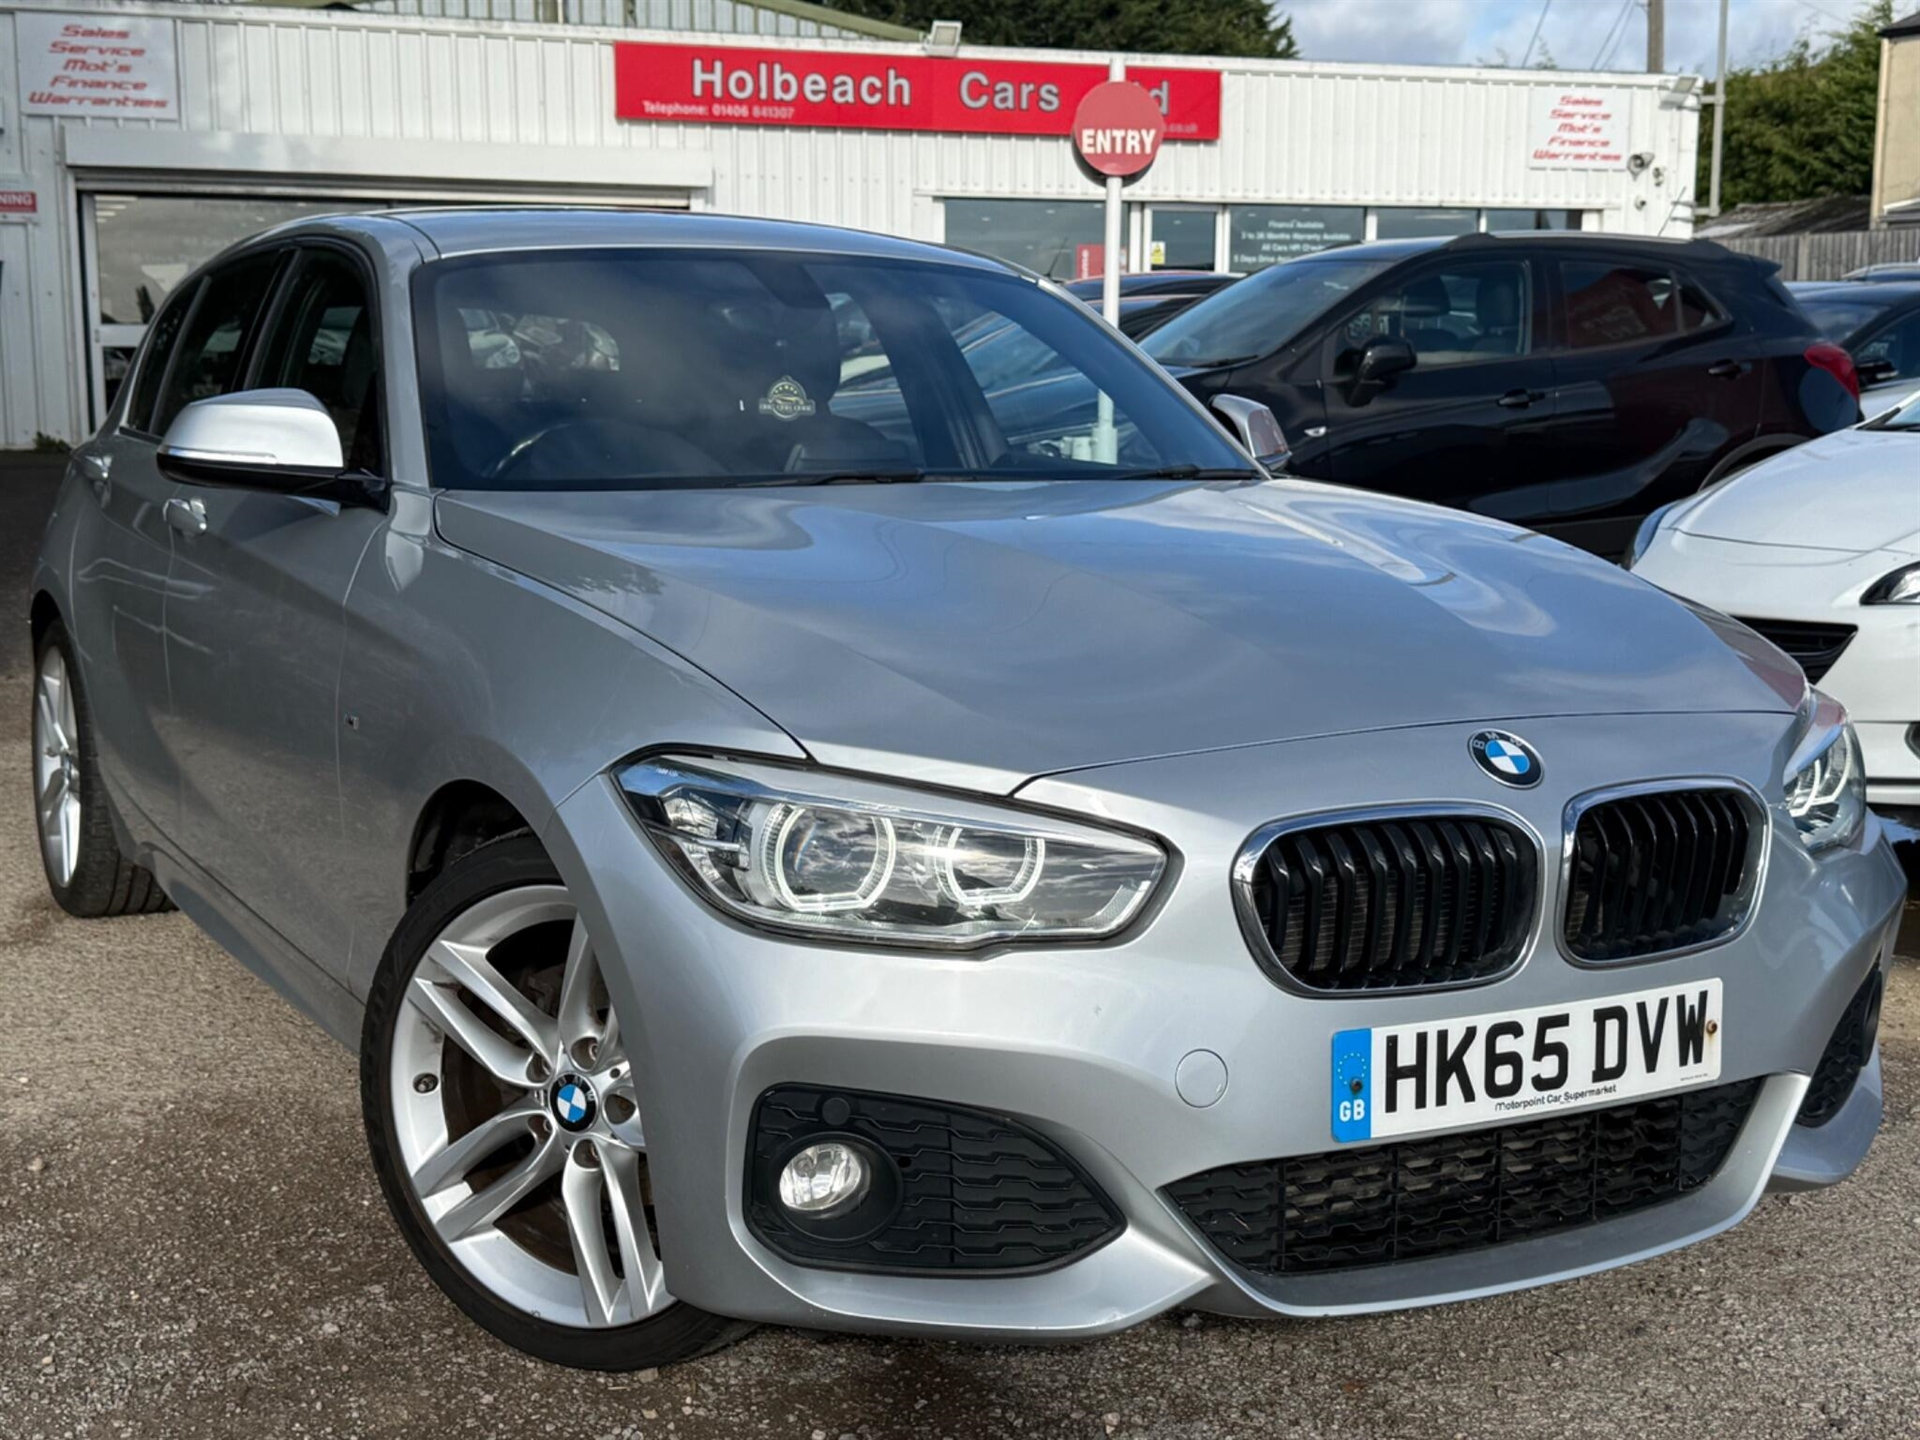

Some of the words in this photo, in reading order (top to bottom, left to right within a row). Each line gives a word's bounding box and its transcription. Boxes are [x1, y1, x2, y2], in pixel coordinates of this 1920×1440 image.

[60, 24, 131, 39] Sales
[49, 41, 145, 57] Service
[62, 59, 132, 73] Mot's
[49, 75, 147, 90] Finance
[692, 58, 912, 107] Holbeach
[959, 70, 1061, 112] Cars
[29, 91, 169, 108] Warranties
[1559, 95, 1603, 106] Sales
[1550, 109, 1612, 121] Service
[1081, 129, 1156, 154] ENTRY
[1547, 136, 1610, 148] Finance
[1384, 1013, 1570, 1113] HK65
[1591, 990, 1709, 1084] DVW
[1495, 1094, 1545, 1112] Motorpoint
[1546, 1093, 1562, 1103] Car
[1563, 1084, 1617, 1101] Supermarket
[1338, 1098, 1366, 1122] GB
